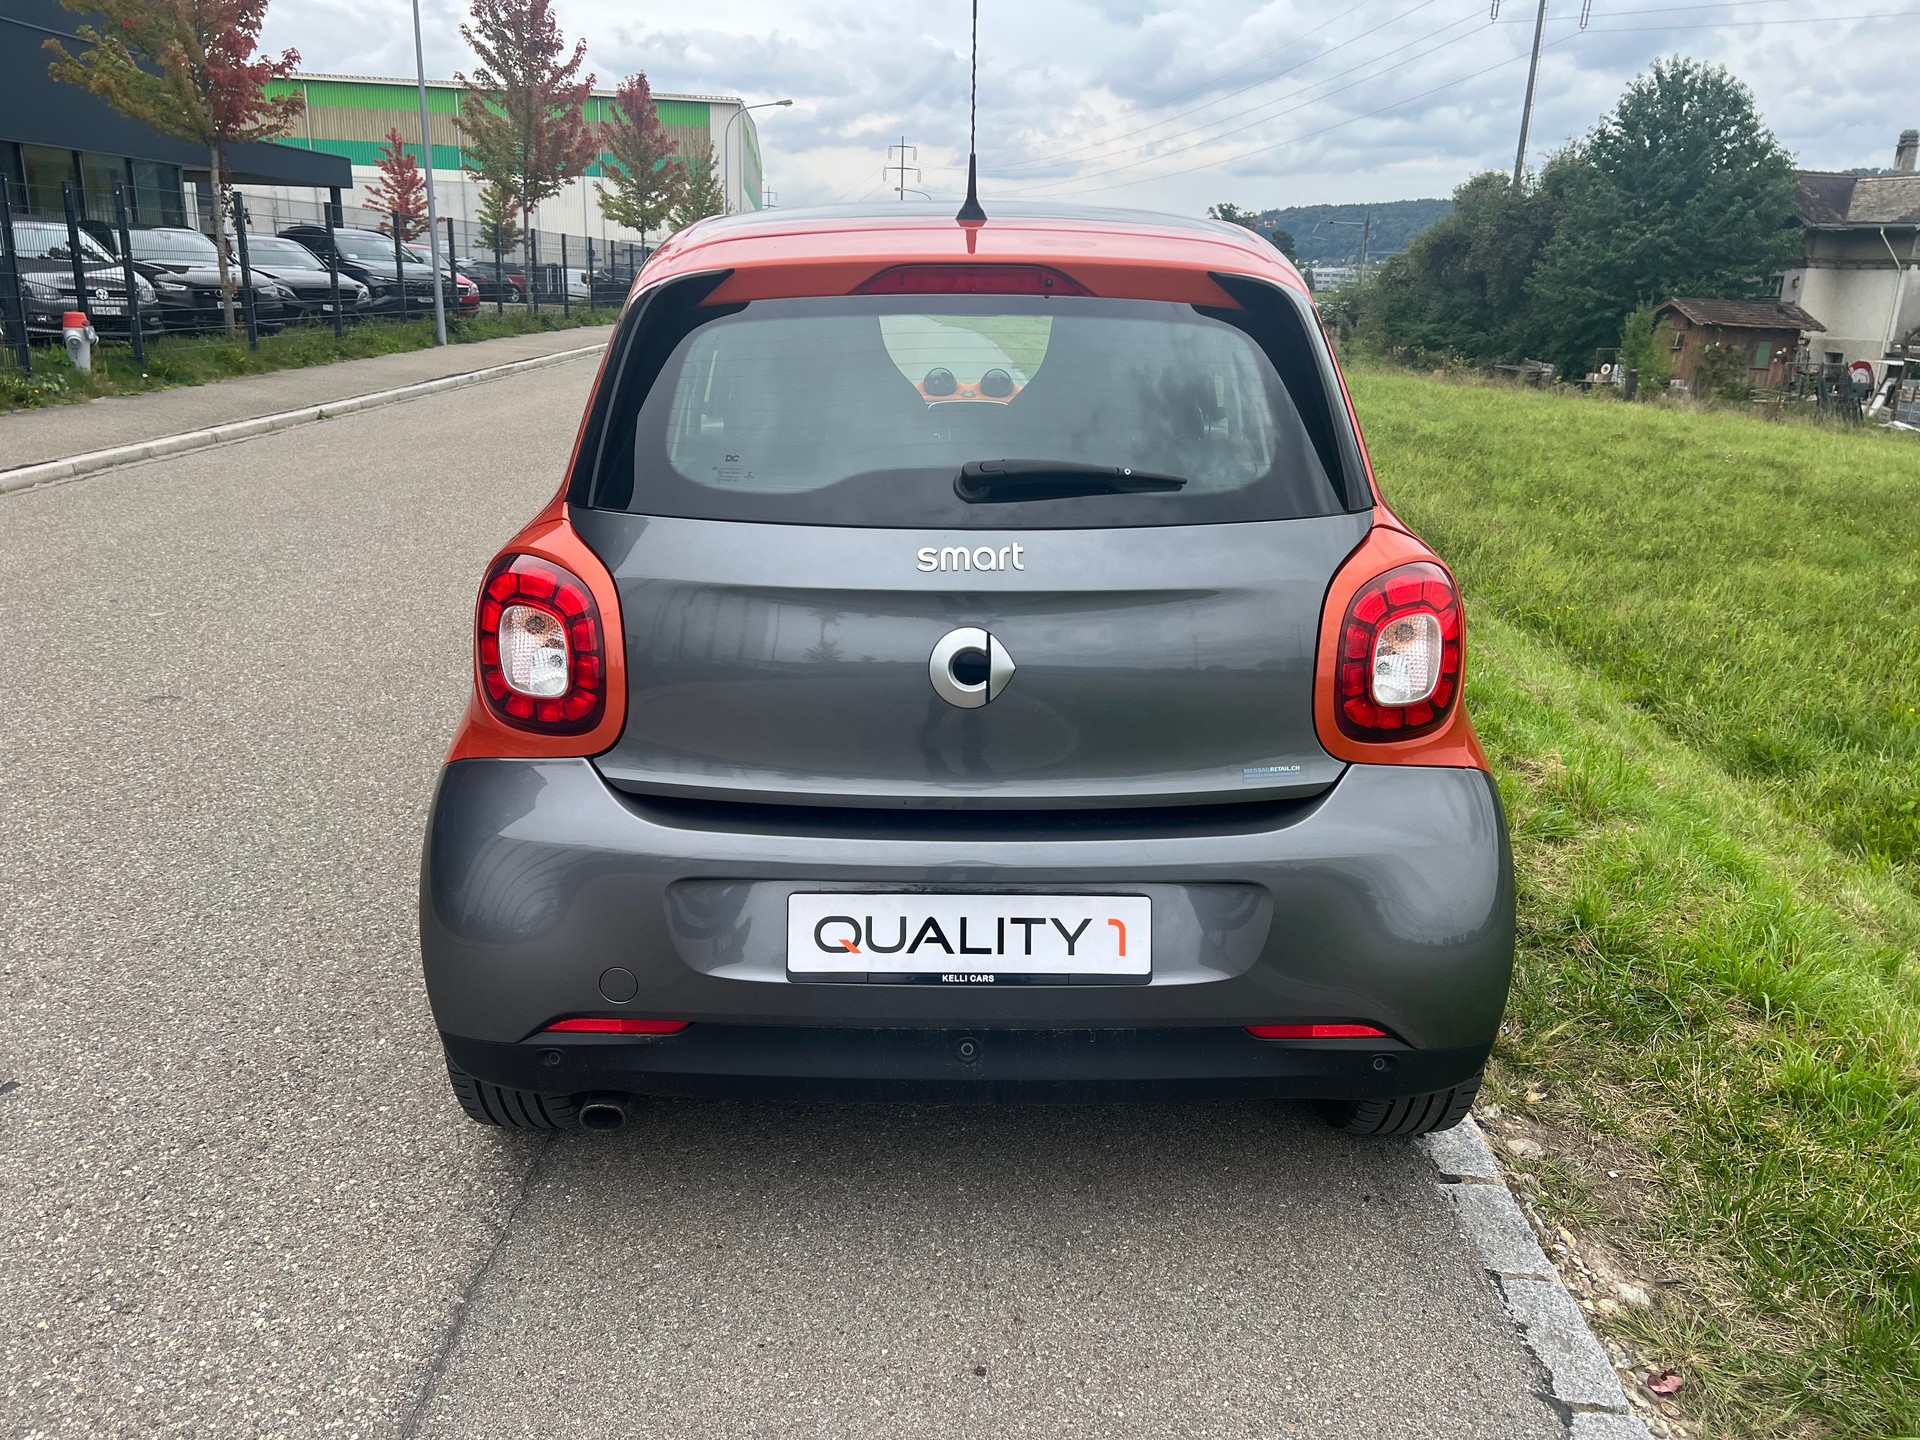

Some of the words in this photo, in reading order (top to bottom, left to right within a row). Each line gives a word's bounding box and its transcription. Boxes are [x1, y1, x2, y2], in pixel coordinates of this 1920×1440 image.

[916, 542, 1025, 572] smart
[813, 915, 1092, 956] QUALITY
[942, 974, 968, 983] KELLI
[969, 974, 995, 983] CARS
